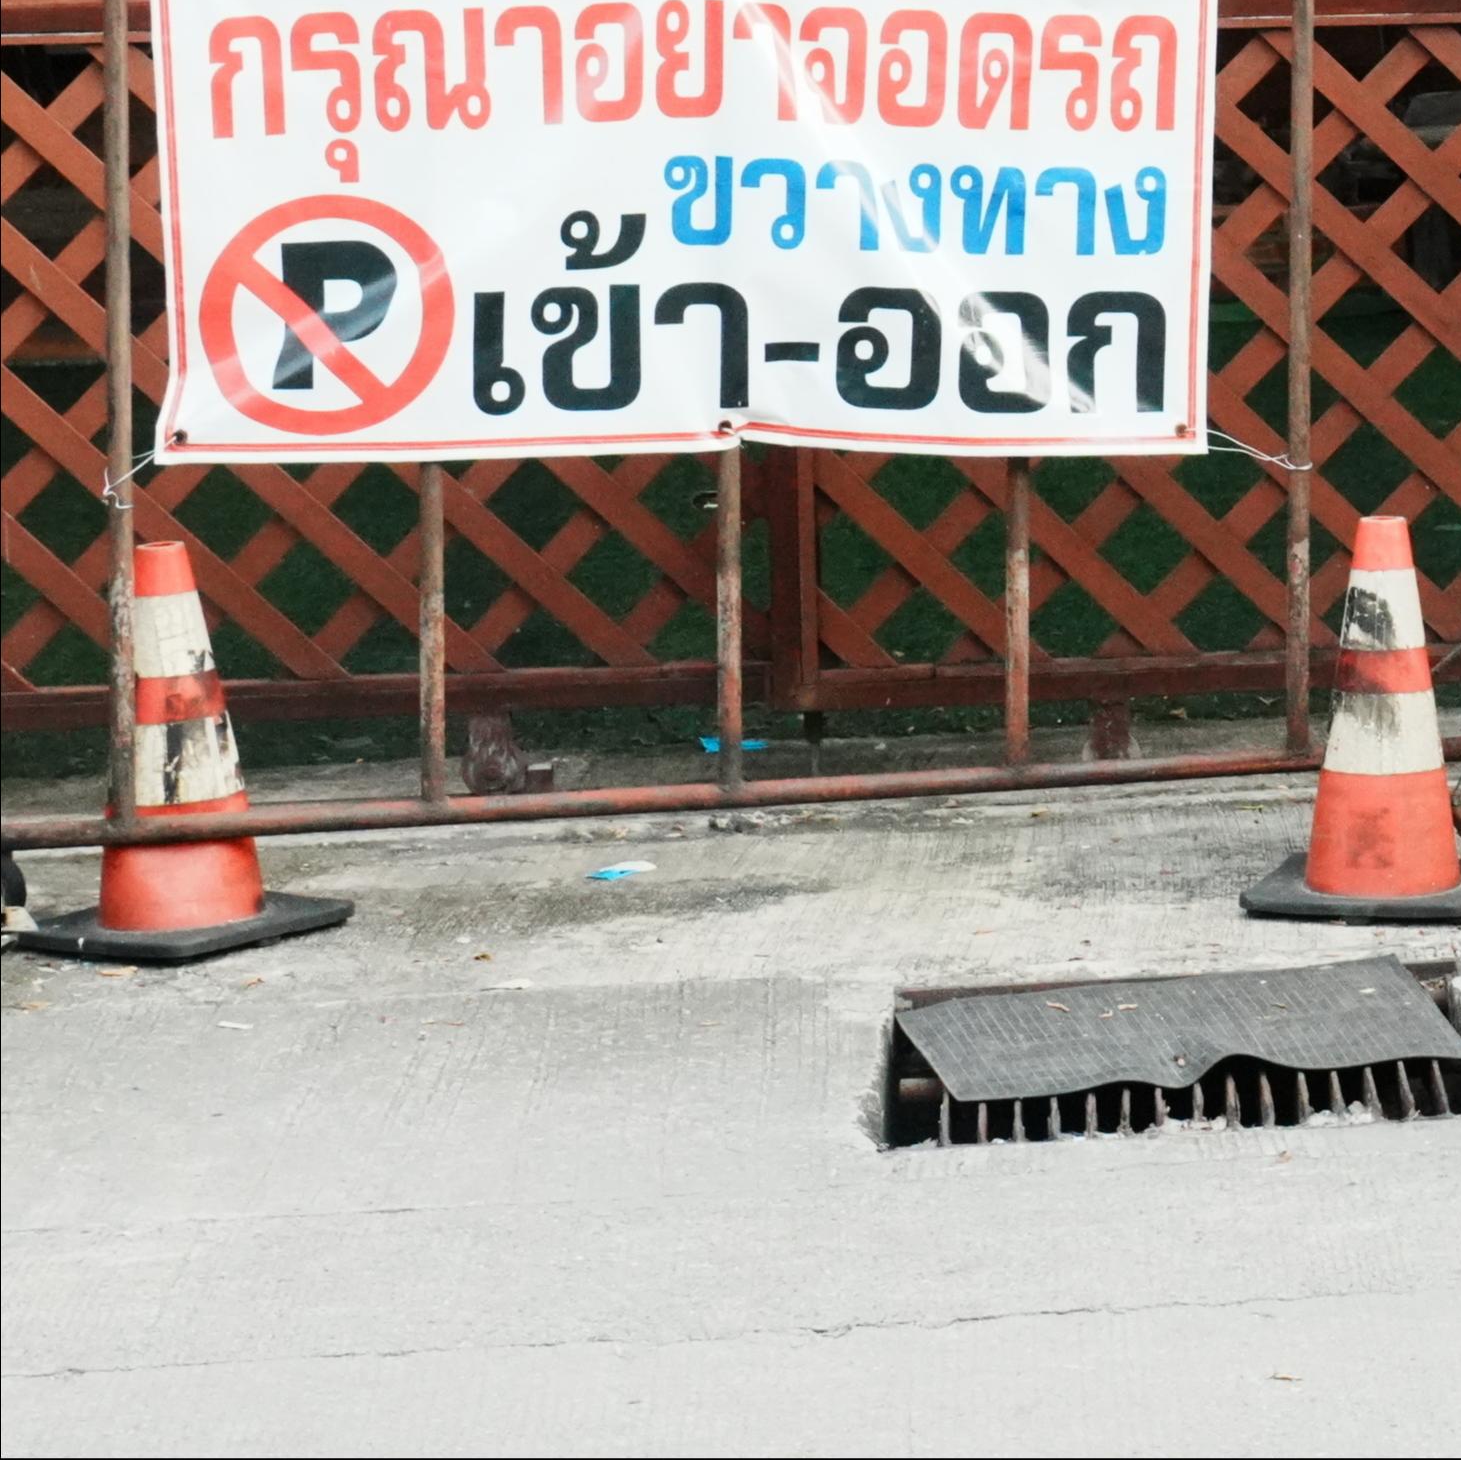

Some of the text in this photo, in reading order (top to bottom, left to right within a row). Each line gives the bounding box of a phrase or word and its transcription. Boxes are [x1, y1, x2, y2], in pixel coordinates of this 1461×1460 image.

[663, 154, 1168, 257] ขวางทาง
[472, 211, 1166, 416] เข้า-ออก
